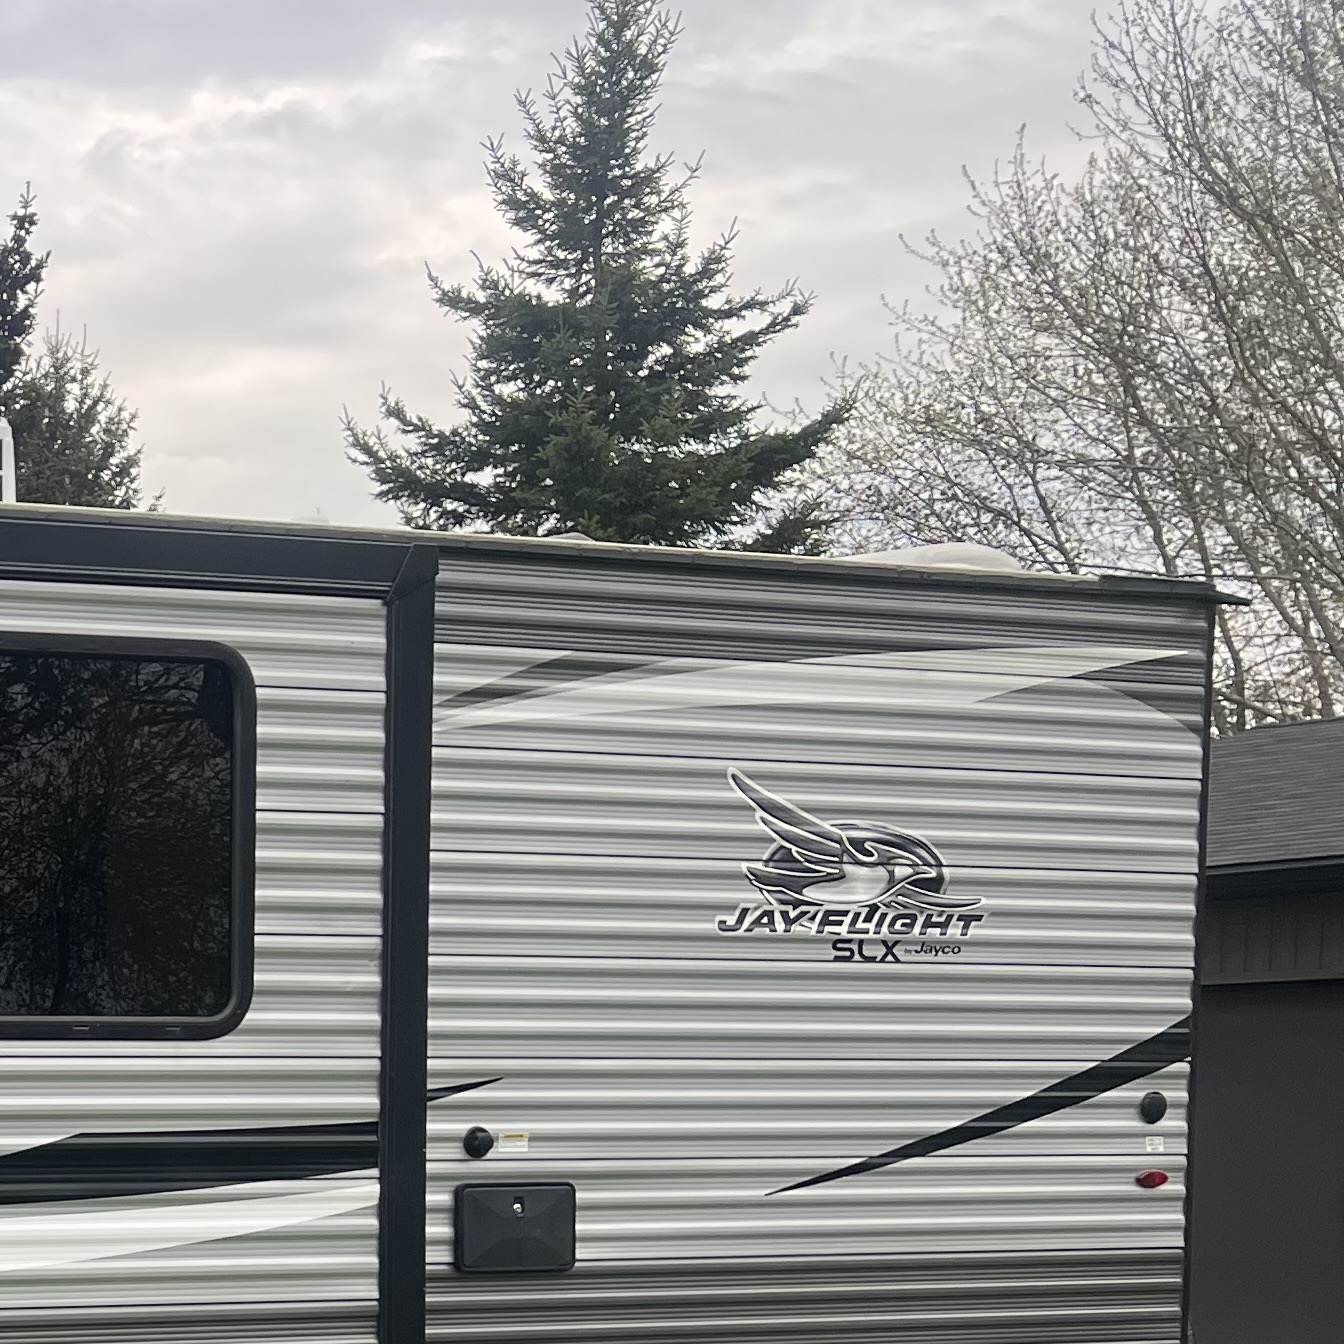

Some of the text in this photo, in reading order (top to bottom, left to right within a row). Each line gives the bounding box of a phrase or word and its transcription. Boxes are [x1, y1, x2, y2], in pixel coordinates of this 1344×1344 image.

[717, 906, 985, 937] JAY FLIGHT
[831, 938, 902, 963] SLX
[914, 941, 962, 958] Jayco
